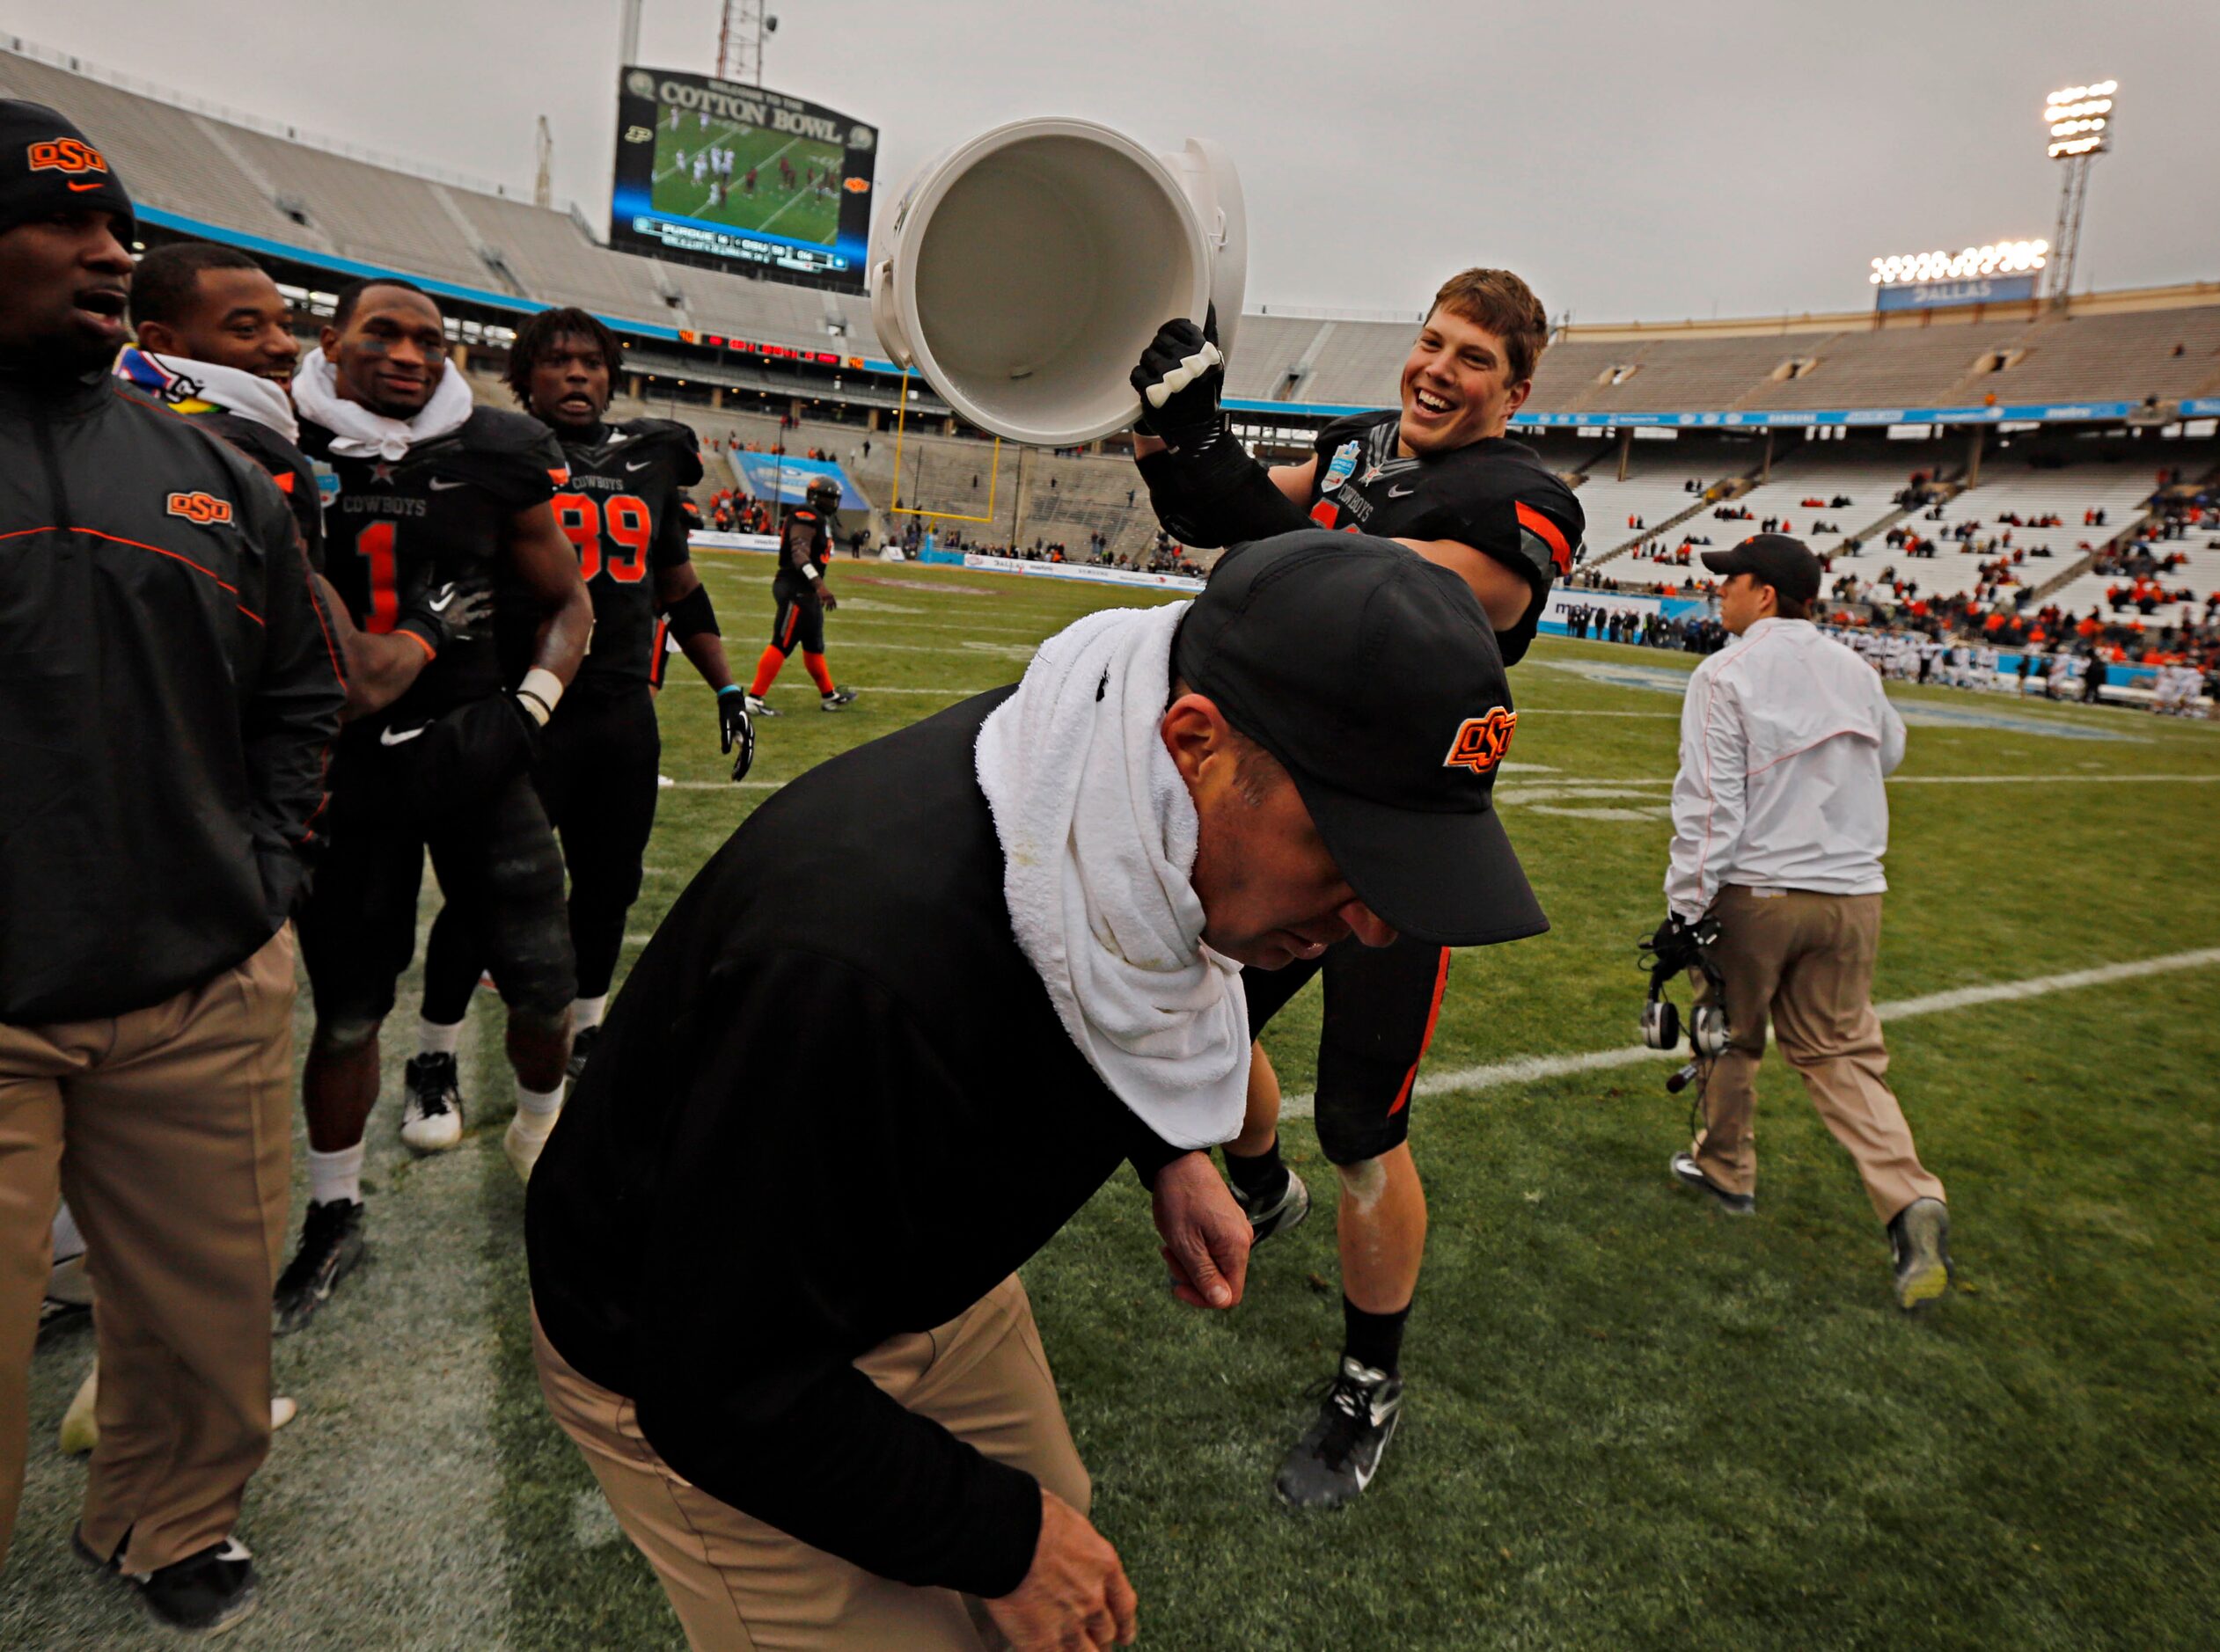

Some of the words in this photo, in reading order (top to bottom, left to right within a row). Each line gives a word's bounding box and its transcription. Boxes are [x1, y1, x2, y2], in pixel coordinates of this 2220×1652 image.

[660, 81, 766, 126] COTTON
[772, 106, 842, 143] BOWL
[27, 137, 107, 173] OSU
[1913, 279, 1992, 303] DALLAS
[571, 475, 624, 491] COWBOYS
[166, 491, 233, 525] OSU
[342, 495, 427, 516] COWBOYS
[1337, 483, 1374, 523] COWBOYS
[355, 520, 399, 634] 1
[1442, 705, 1517, 774] OSU
